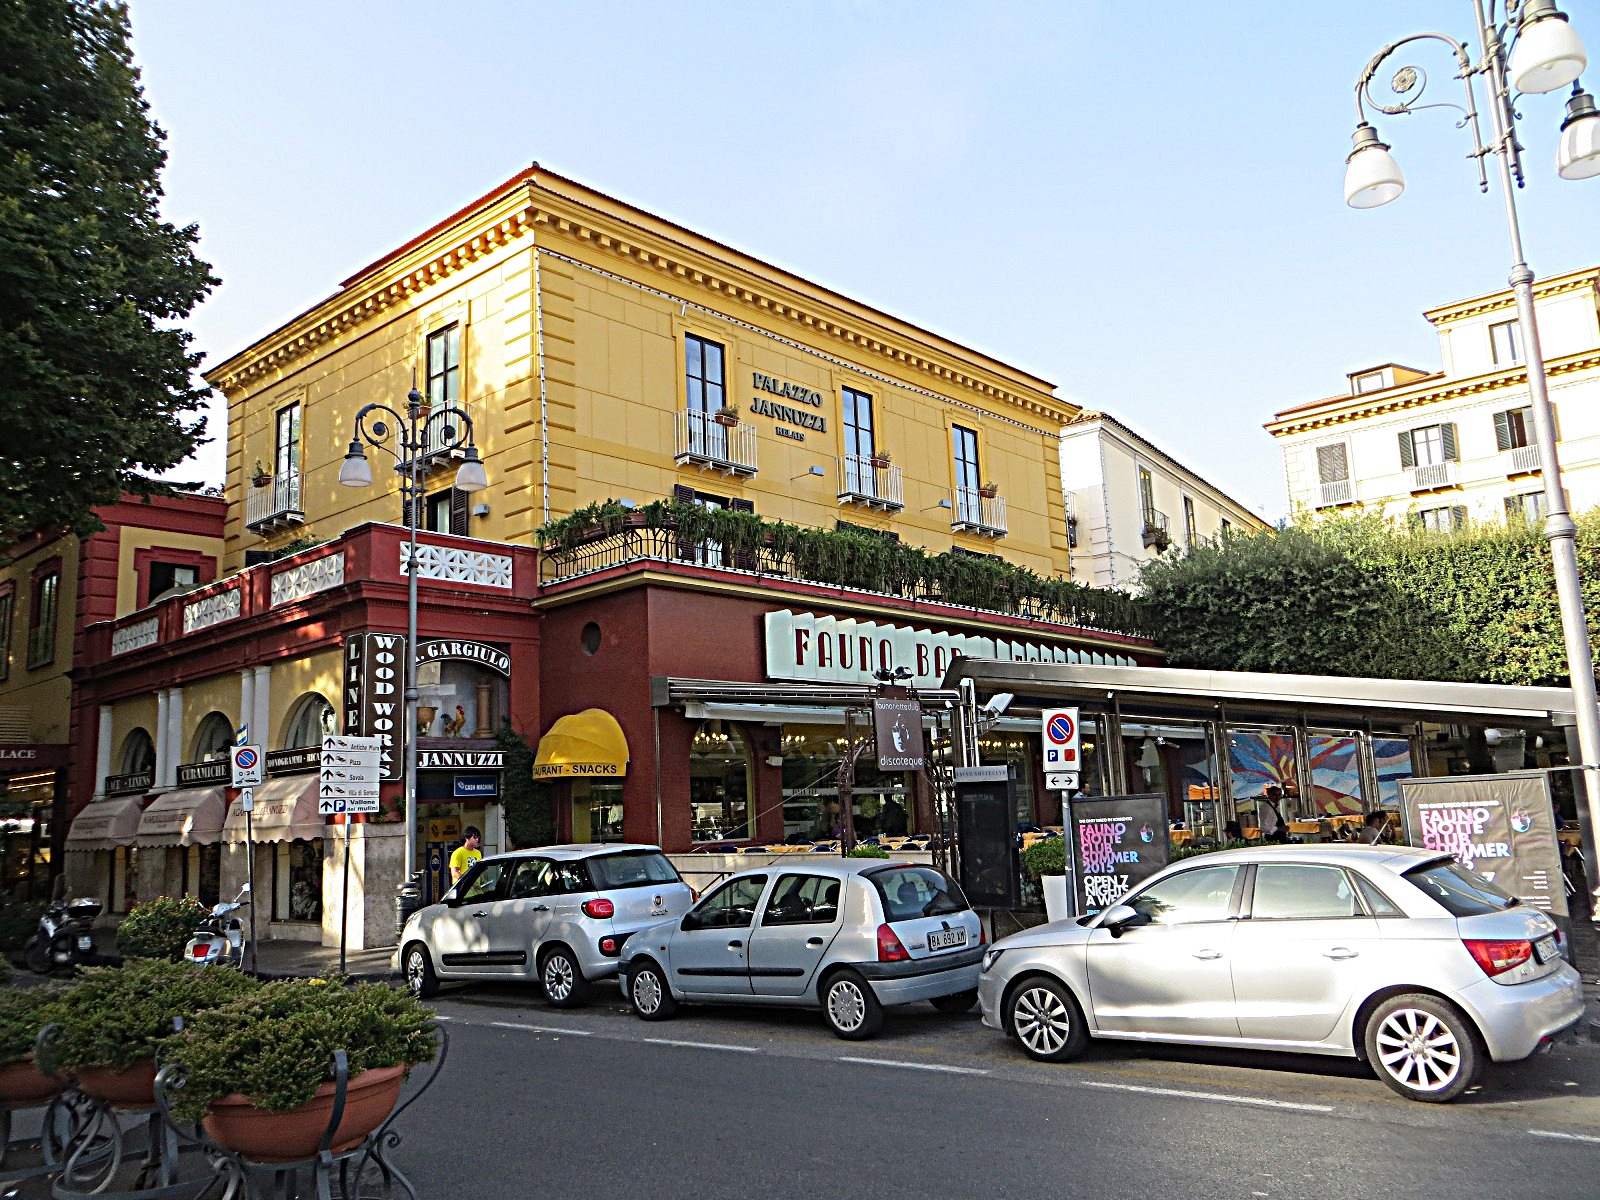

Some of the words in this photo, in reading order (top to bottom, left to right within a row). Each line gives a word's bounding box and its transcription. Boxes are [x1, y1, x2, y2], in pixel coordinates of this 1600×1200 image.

[752, 372, 824, 408] PALAZZO
[750, 397, 827, 433] JANNUZZI
[427, 642, 509, 669] GARGIULO
[795, 628, 893, 672] FAUNO
[916, 643, 963, 678] BA
[373, 635, 398, 695] WOOD
[347, 643, 360, 737] LINE
[418, 752, 504, 767] JANNUZZI
[880, 755, 923, 768] discoteque
[181, 764, 227, 781] CERAMICHE
[572, 764, 617, 774] SNACKS
[128, 776, 151, 788] LINENS
[1420, 808, 1490, 823] FAUNO
[1080, 823, 1126, 835] FAUNO
[1421, 821, 1484, 835] NOTTE
[1080, 834, 1122, 844] NOTTE
[1423, 833, 1471, 846] CLUB
[1081, 843, 1113, 854] CLUB
[1082, 851, 1139, 863] SUMMER
[1083, 861, 1115, 873] 2015
[1083, 875, 1117, 887] OPEN
[1085, 895, 1097, 906] A
[943, 932, 955, 945] 692
